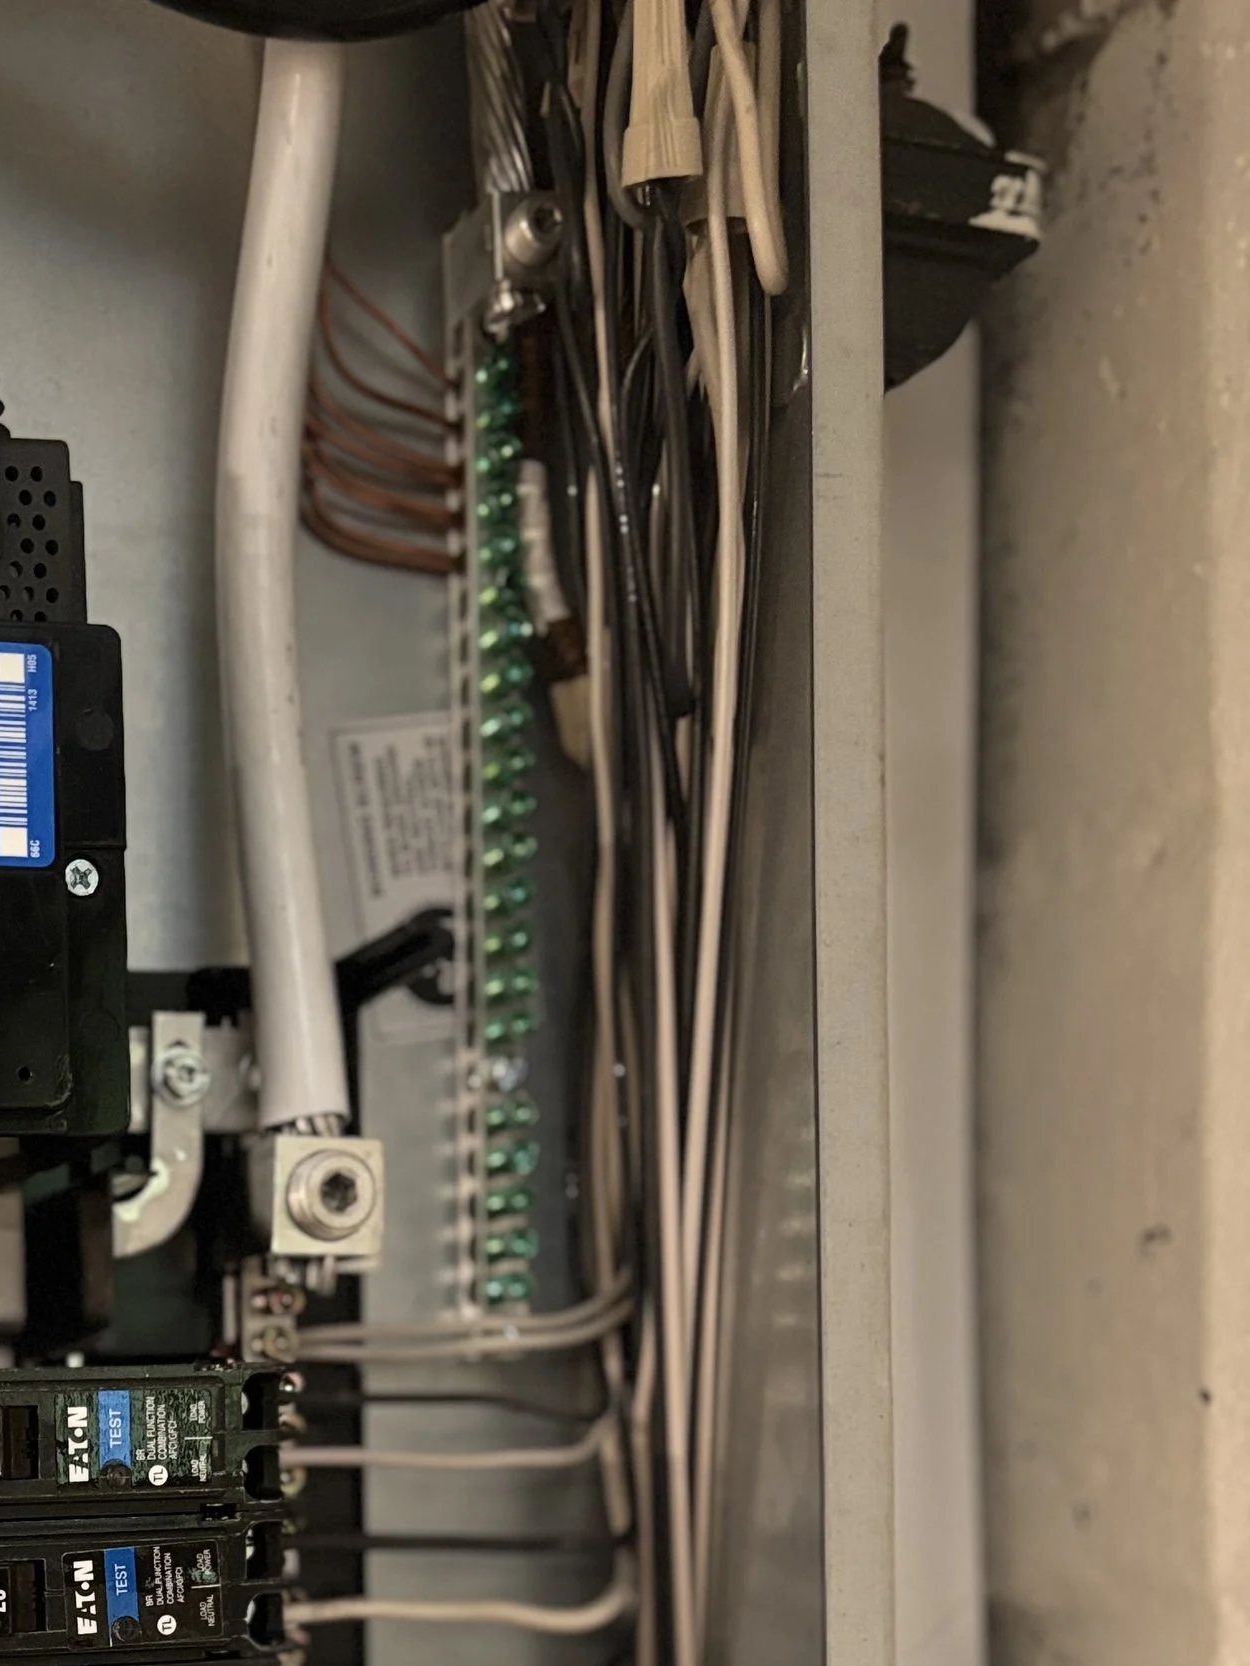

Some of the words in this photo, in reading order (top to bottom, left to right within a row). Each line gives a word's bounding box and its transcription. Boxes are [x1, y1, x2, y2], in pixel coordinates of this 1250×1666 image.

[25, 689, 39, 711] 1413
[67, 1407, 88, 1482] EATON
[110, 1408, 121, 1448] TEST
[72, 1561, 96, 1634] EATON
[117, 1564, 128, 1596] TEST
